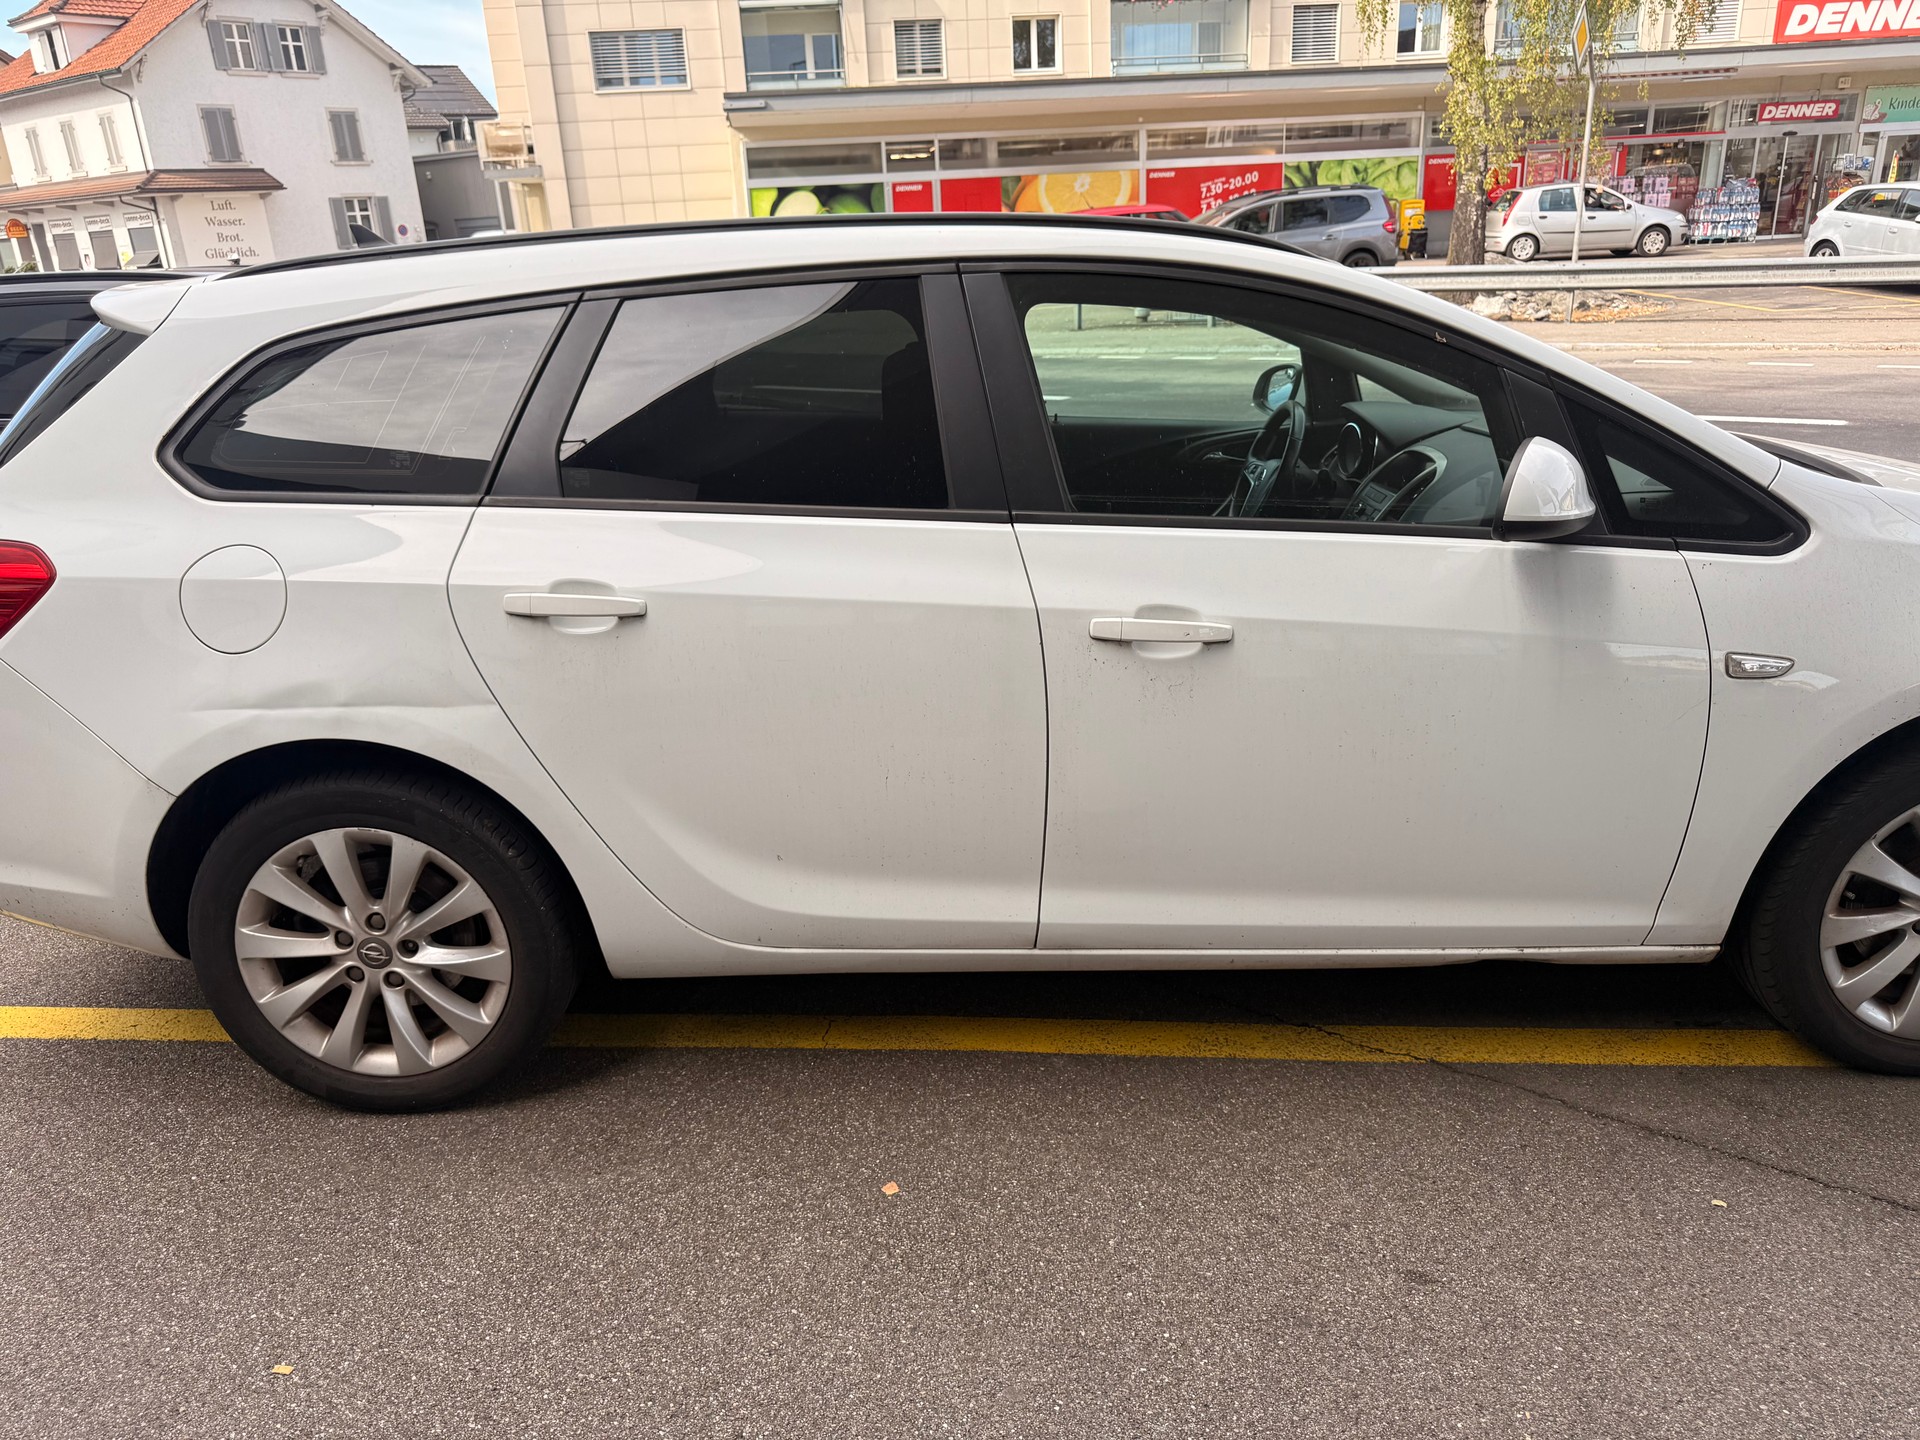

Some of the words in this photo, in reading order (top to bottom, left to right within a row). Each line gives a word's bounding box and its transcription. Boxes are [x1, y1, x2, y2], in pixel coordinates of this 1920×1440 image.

[1762, 102, 1836, 119] DENNER
[895, 184, 923, 192] DENNER
[210, 199, 236, 211] Luft.
[204, 216, 246, 227] Wasser.
[216, 232, 244, 243] Brot.
